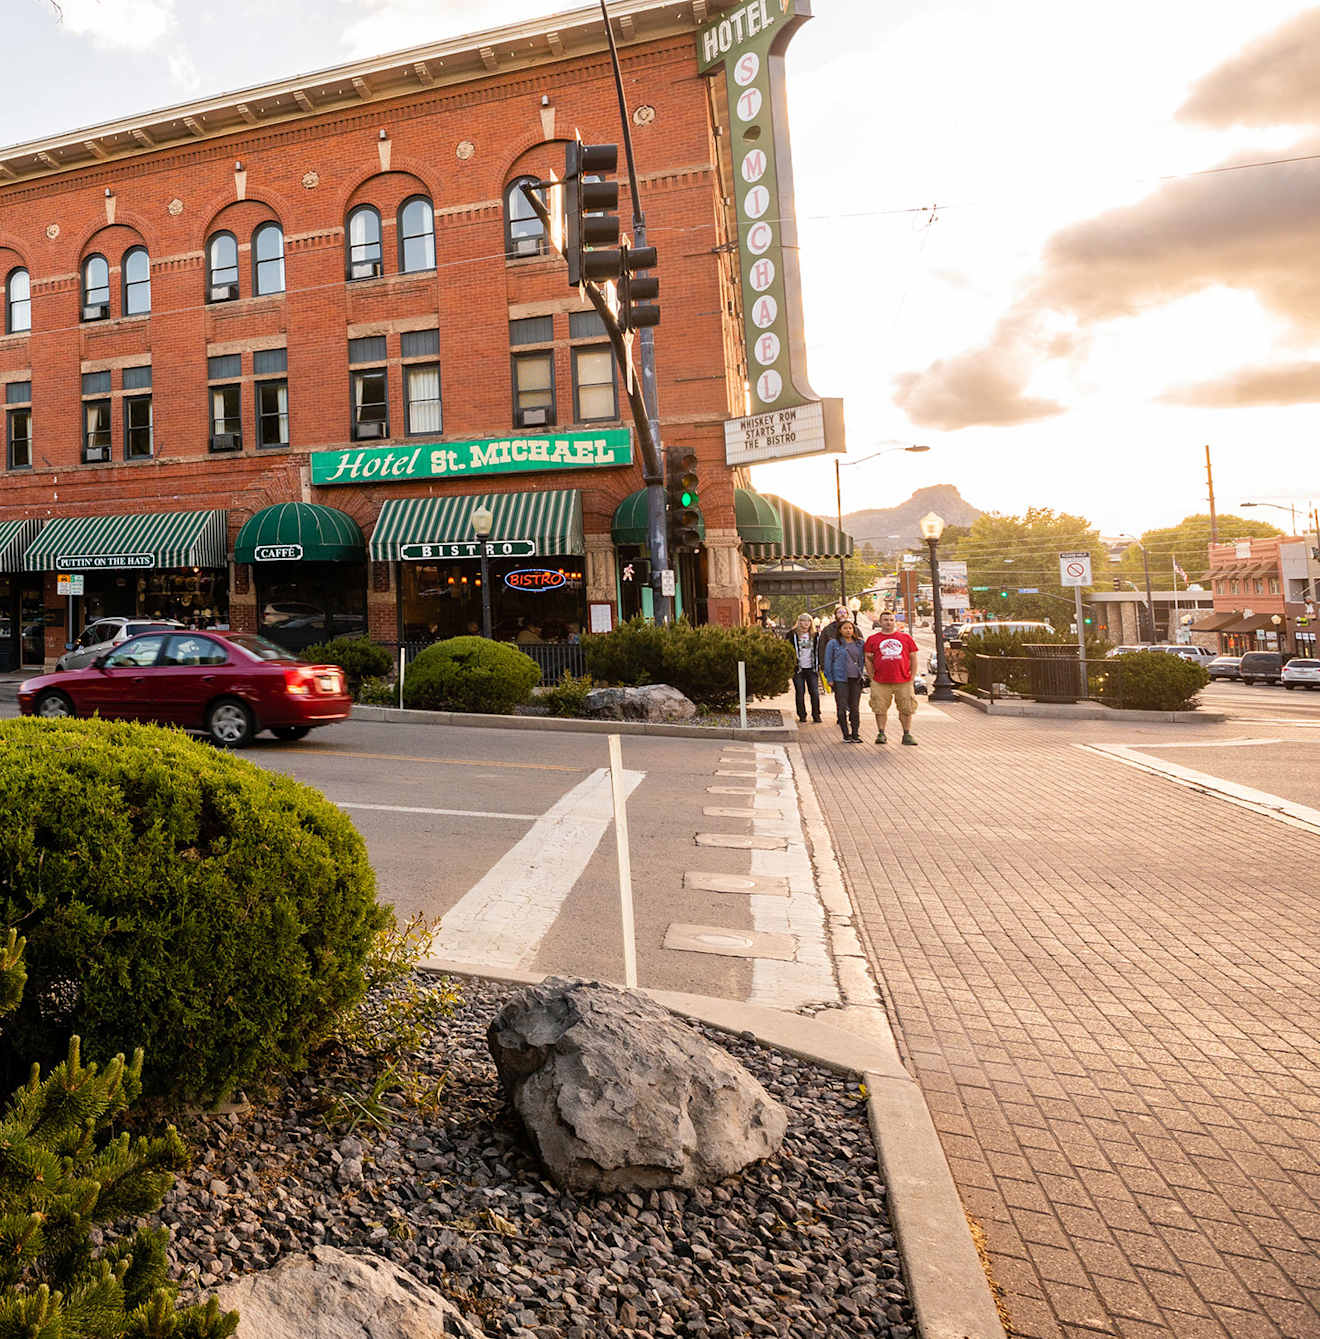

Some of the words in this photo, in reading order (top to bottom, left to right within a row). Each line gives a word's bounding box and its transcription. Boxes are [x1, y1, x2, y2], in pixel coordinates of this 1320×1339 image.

[703, 0, 775, 63] HOTEL
[745, 152, 779, 398] MICHAEL
[741, 415, 774, 430] WHISKEY
[779, 410, 797, 420] ROW
[746, 426, 775, 439] STARTS
[781, 423, 792, 432] AT
[744, 440, 759, 450] THE
[767, 433, 796, 446] BISTRO
[325, 448, 422, 481] Hotel
[430, 449, 466, 474] St.
[470, 439, 615, 468] MICHAEL
[422, 543, 513, 557] BISTRO
[94, 558, 107, 566] ON
[107, 557, 126, 566] THE
[127, 556, 151, 565] HATS
[509, 574, 562, 586] BISTRO
